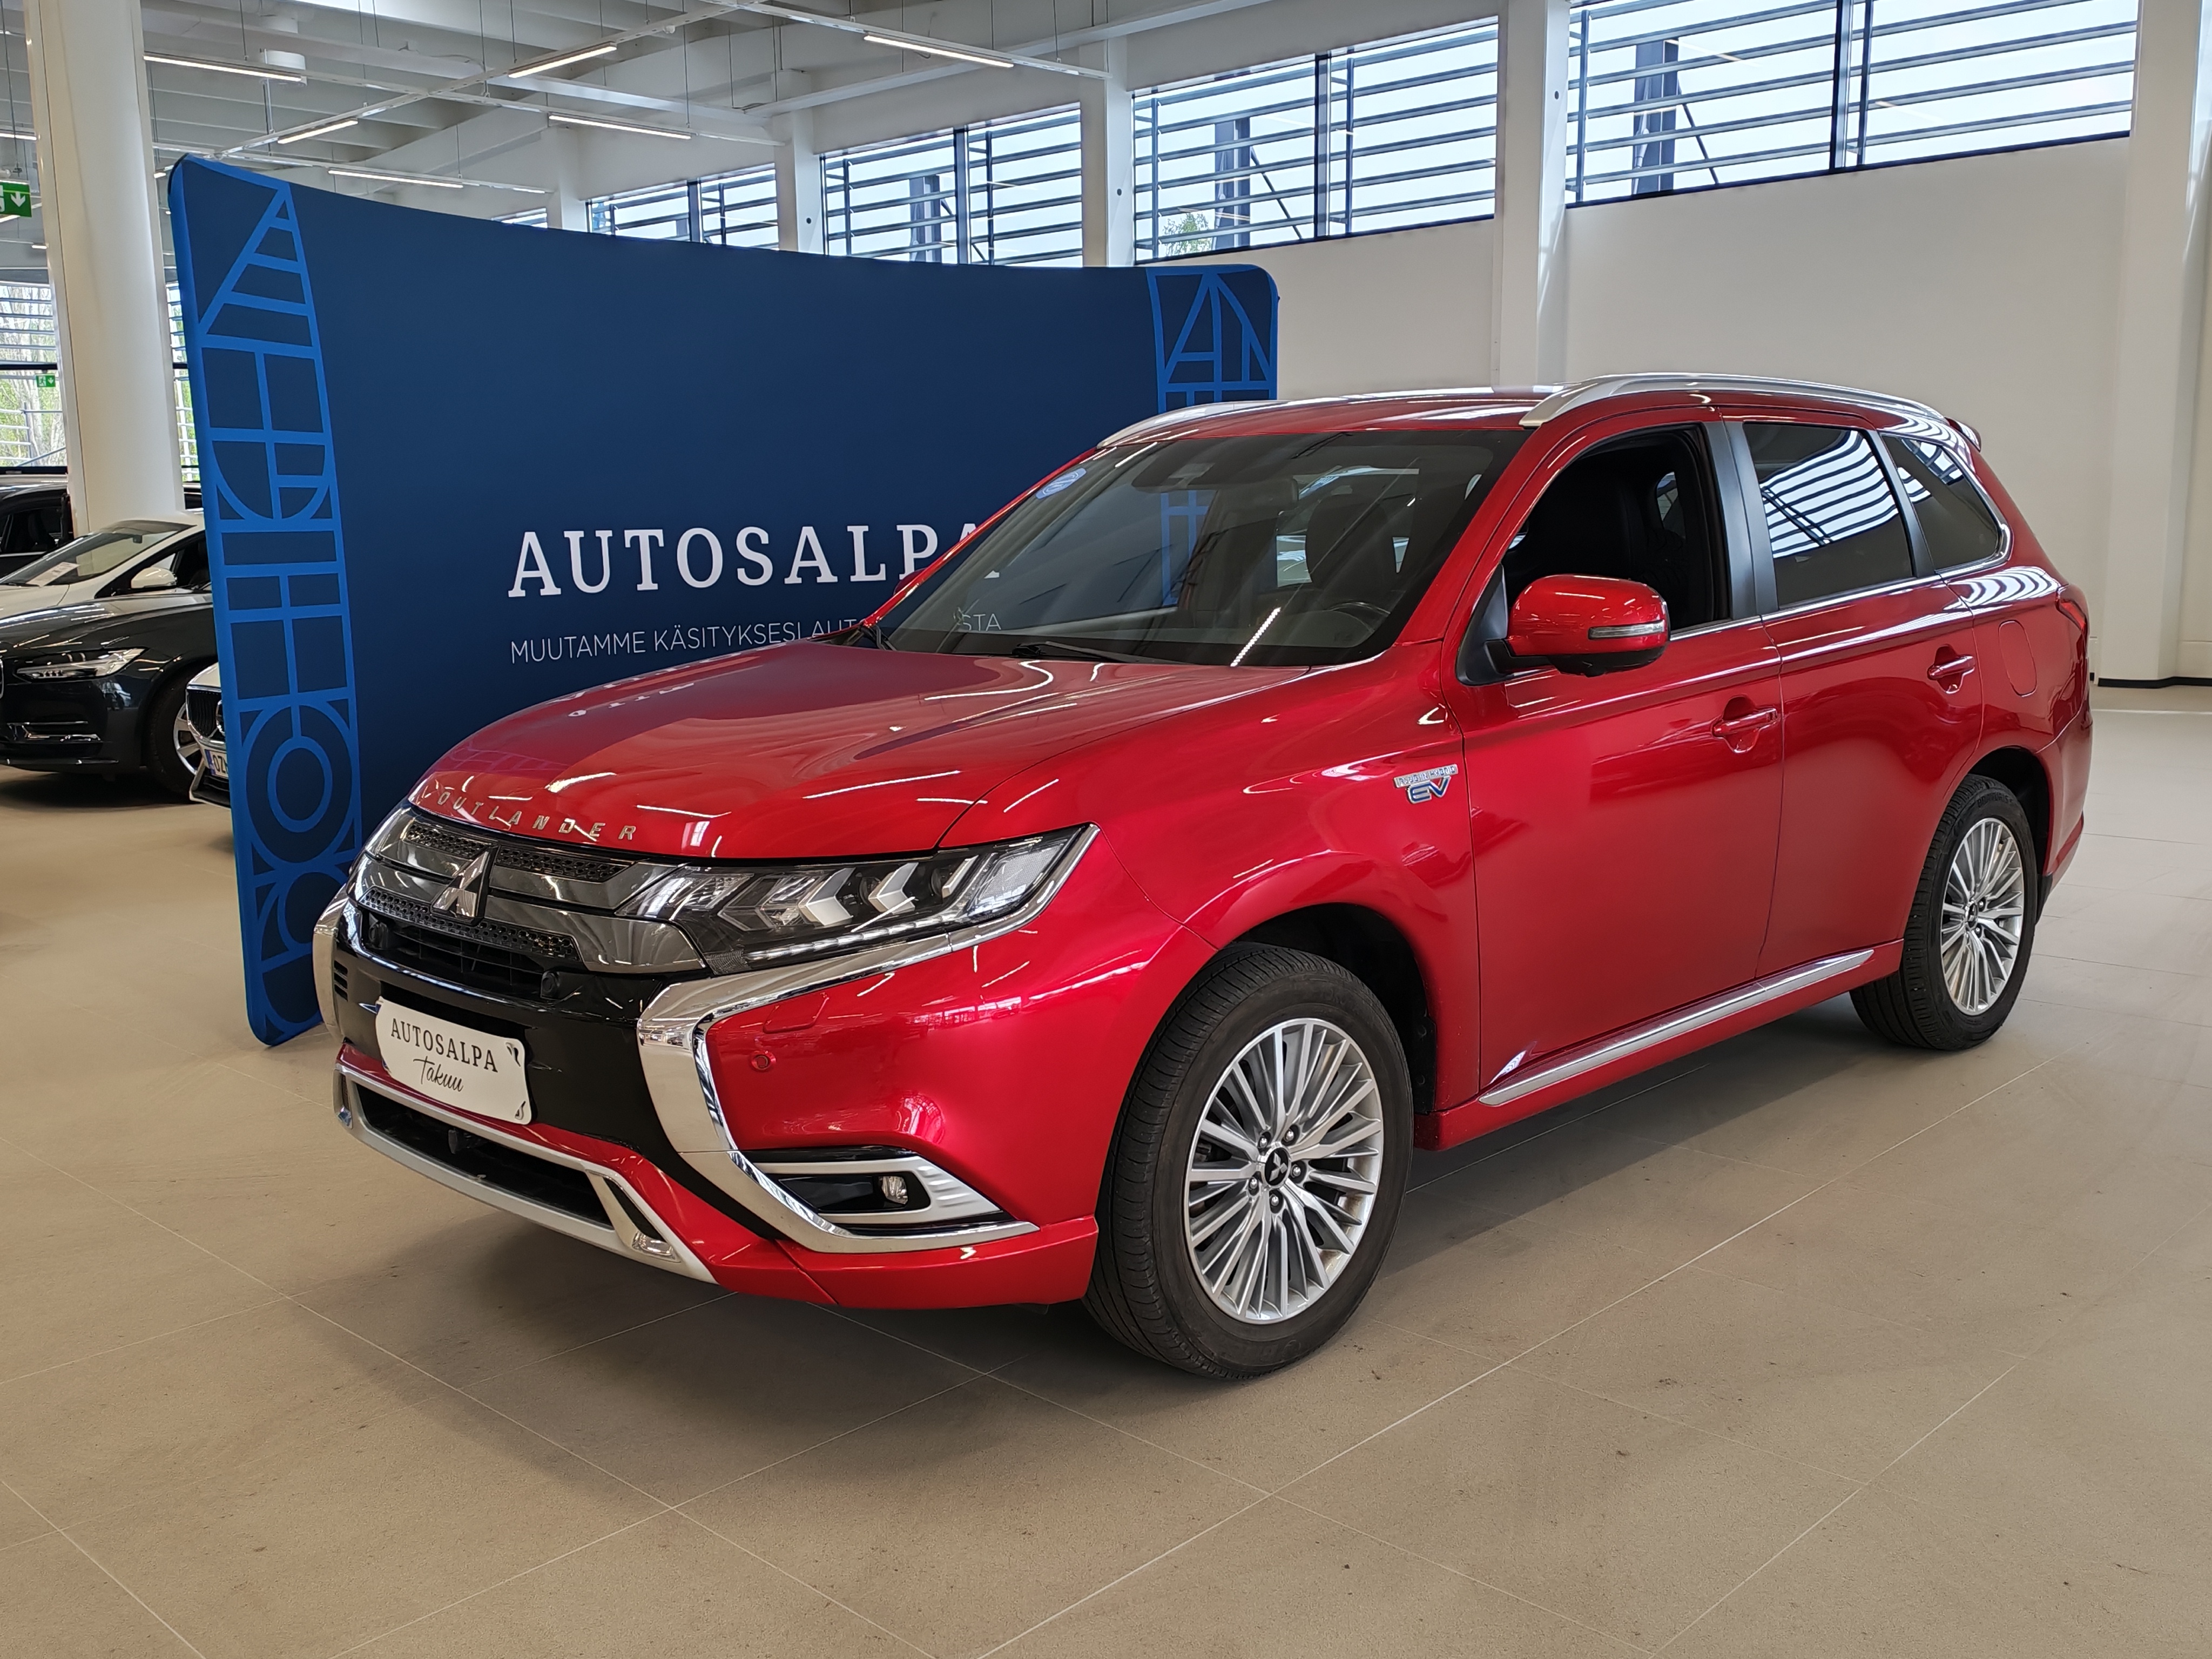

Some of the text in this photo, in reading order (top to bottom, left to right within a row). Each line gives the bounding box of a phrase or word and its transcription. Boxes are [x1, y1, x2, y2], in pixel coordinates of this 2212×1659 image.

[511, 631, 646, 664] MUUTAMME
[654, 621, 800, 651] KÄSITYKSESI
[1408, 775, 1451, 804] EV
[436, 791, 637, 841] OUTLANDER
[390, 1018, 498, 1073] AUTOSALPA
[413, 1055, 464, 1092] Takuu
